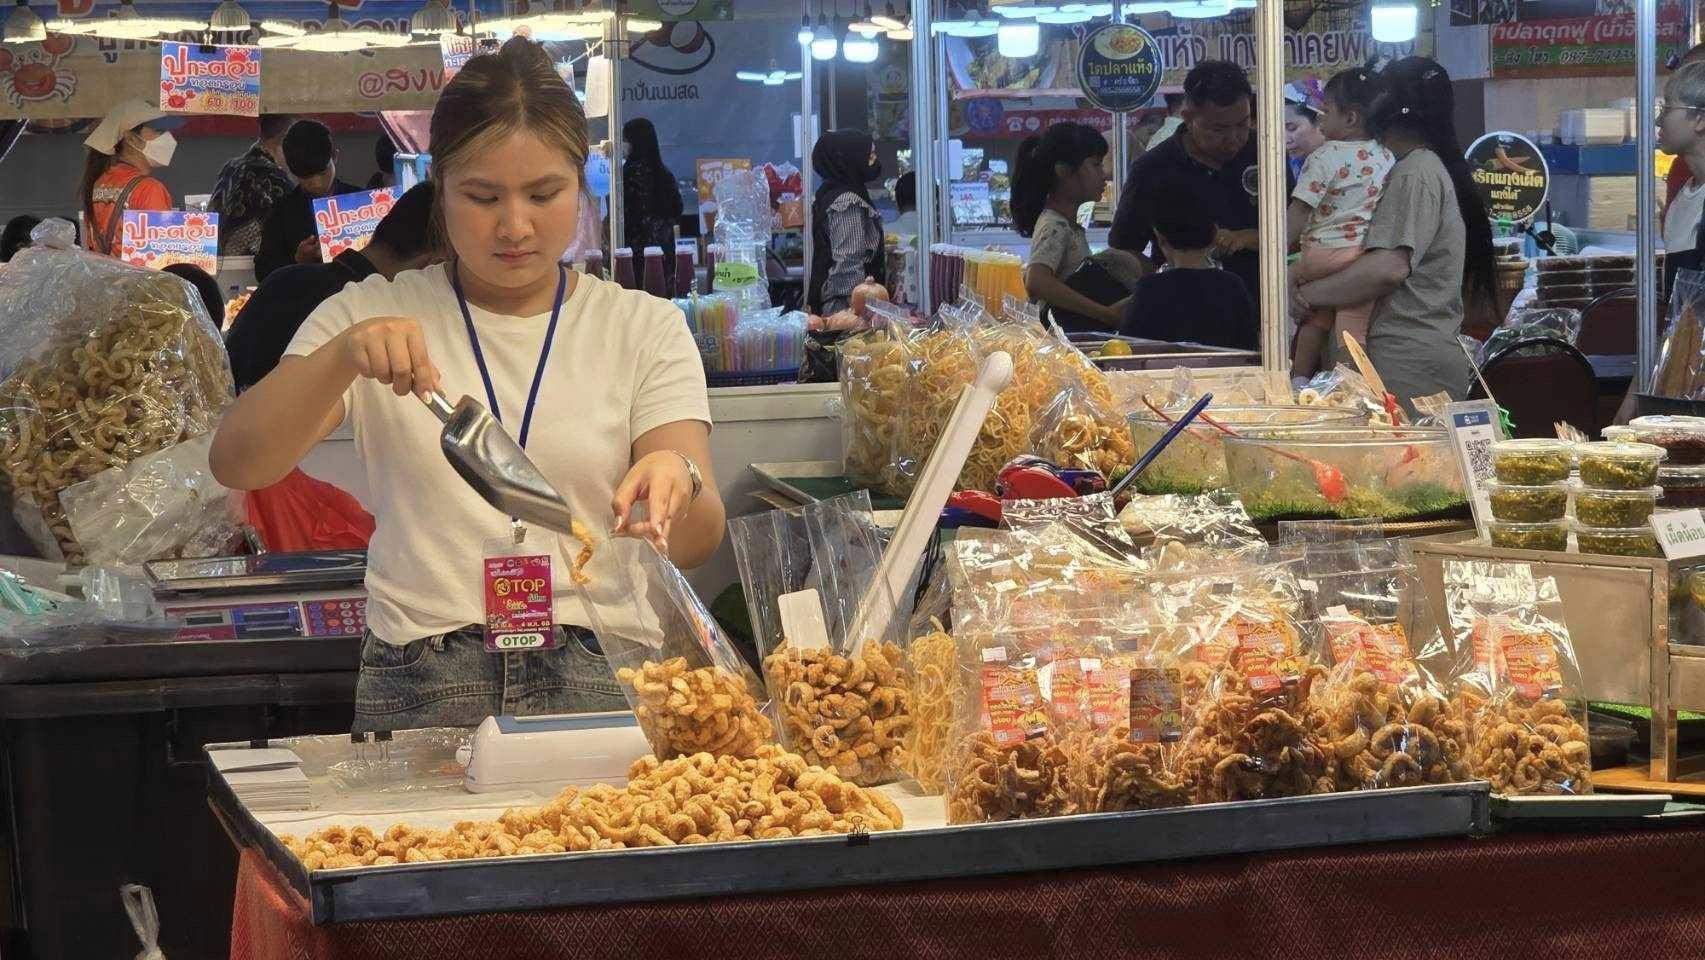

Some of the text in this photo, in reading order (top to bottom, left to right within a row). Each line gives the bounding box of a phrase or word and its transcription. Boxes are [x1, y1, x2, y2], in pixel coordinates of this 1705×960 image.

[315, 199, 393, 237] ปูกะตอ
[502, 635, 538, 647] OTOP
